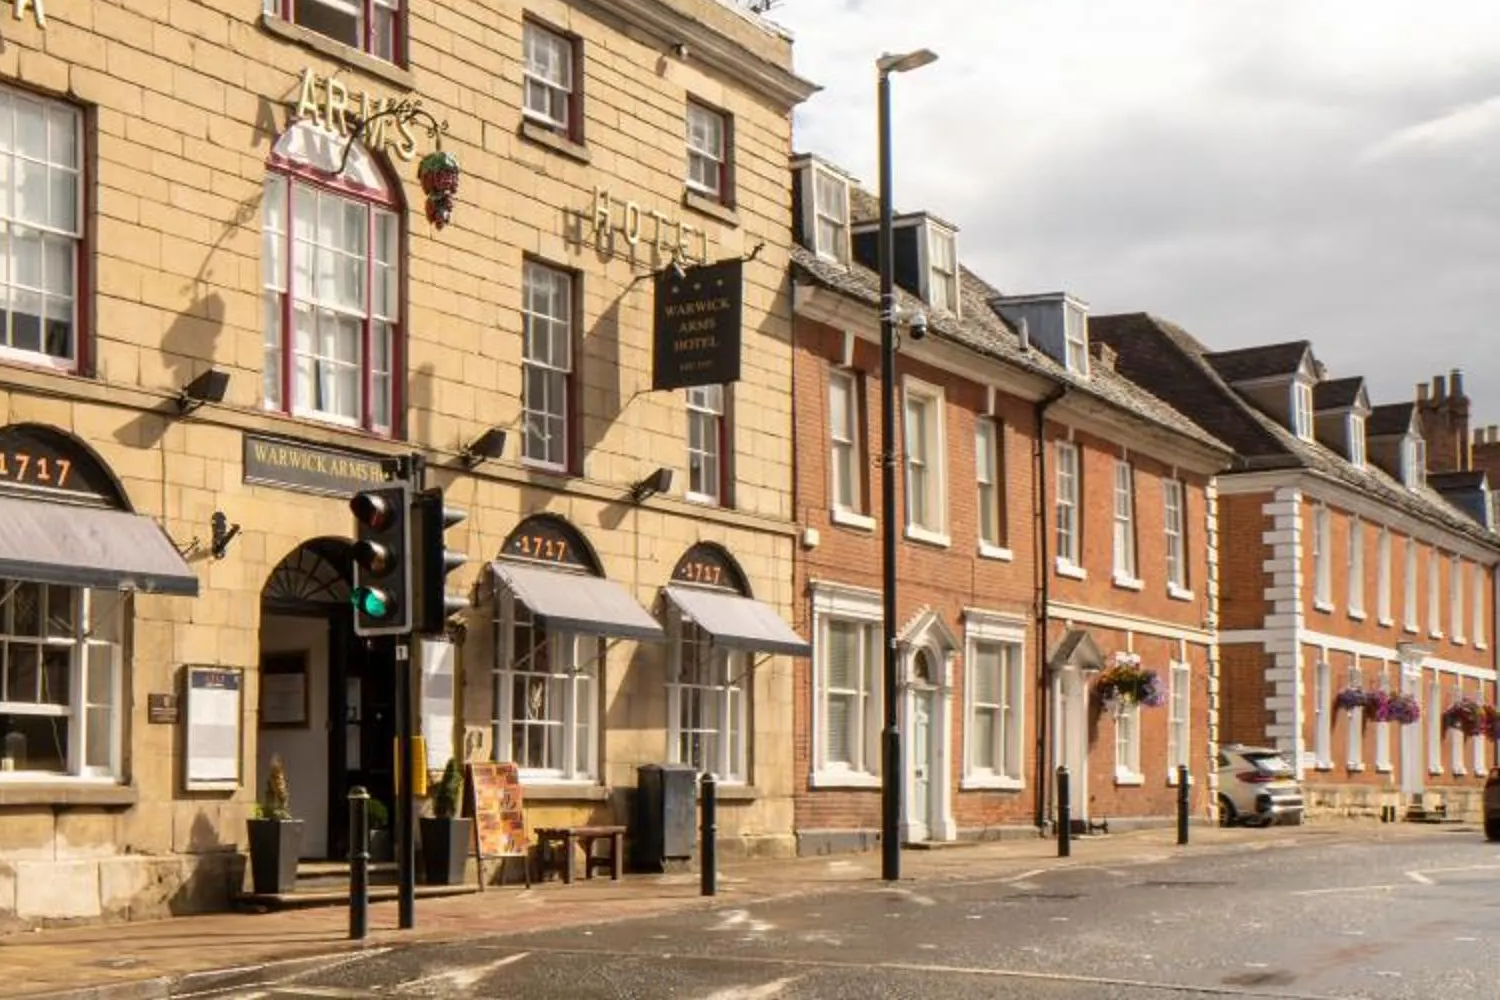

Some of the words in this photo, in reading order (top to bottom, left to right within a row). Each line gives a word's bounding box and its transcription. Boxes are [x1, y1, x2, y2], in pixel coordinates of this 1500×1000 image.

[298, 67, 416, 163] ARMS
[665, 298, 731, 317] WARWICK
[679, 318, 716, 333] ARMS
[674, 336, 719, 352] HOTEL
[255, 442, 327, 473] WARWICK
[330, 459, 368, 479] ARMS
[521, 536, 566, 561] 1717
[687, 562, 721, 585] 1717
